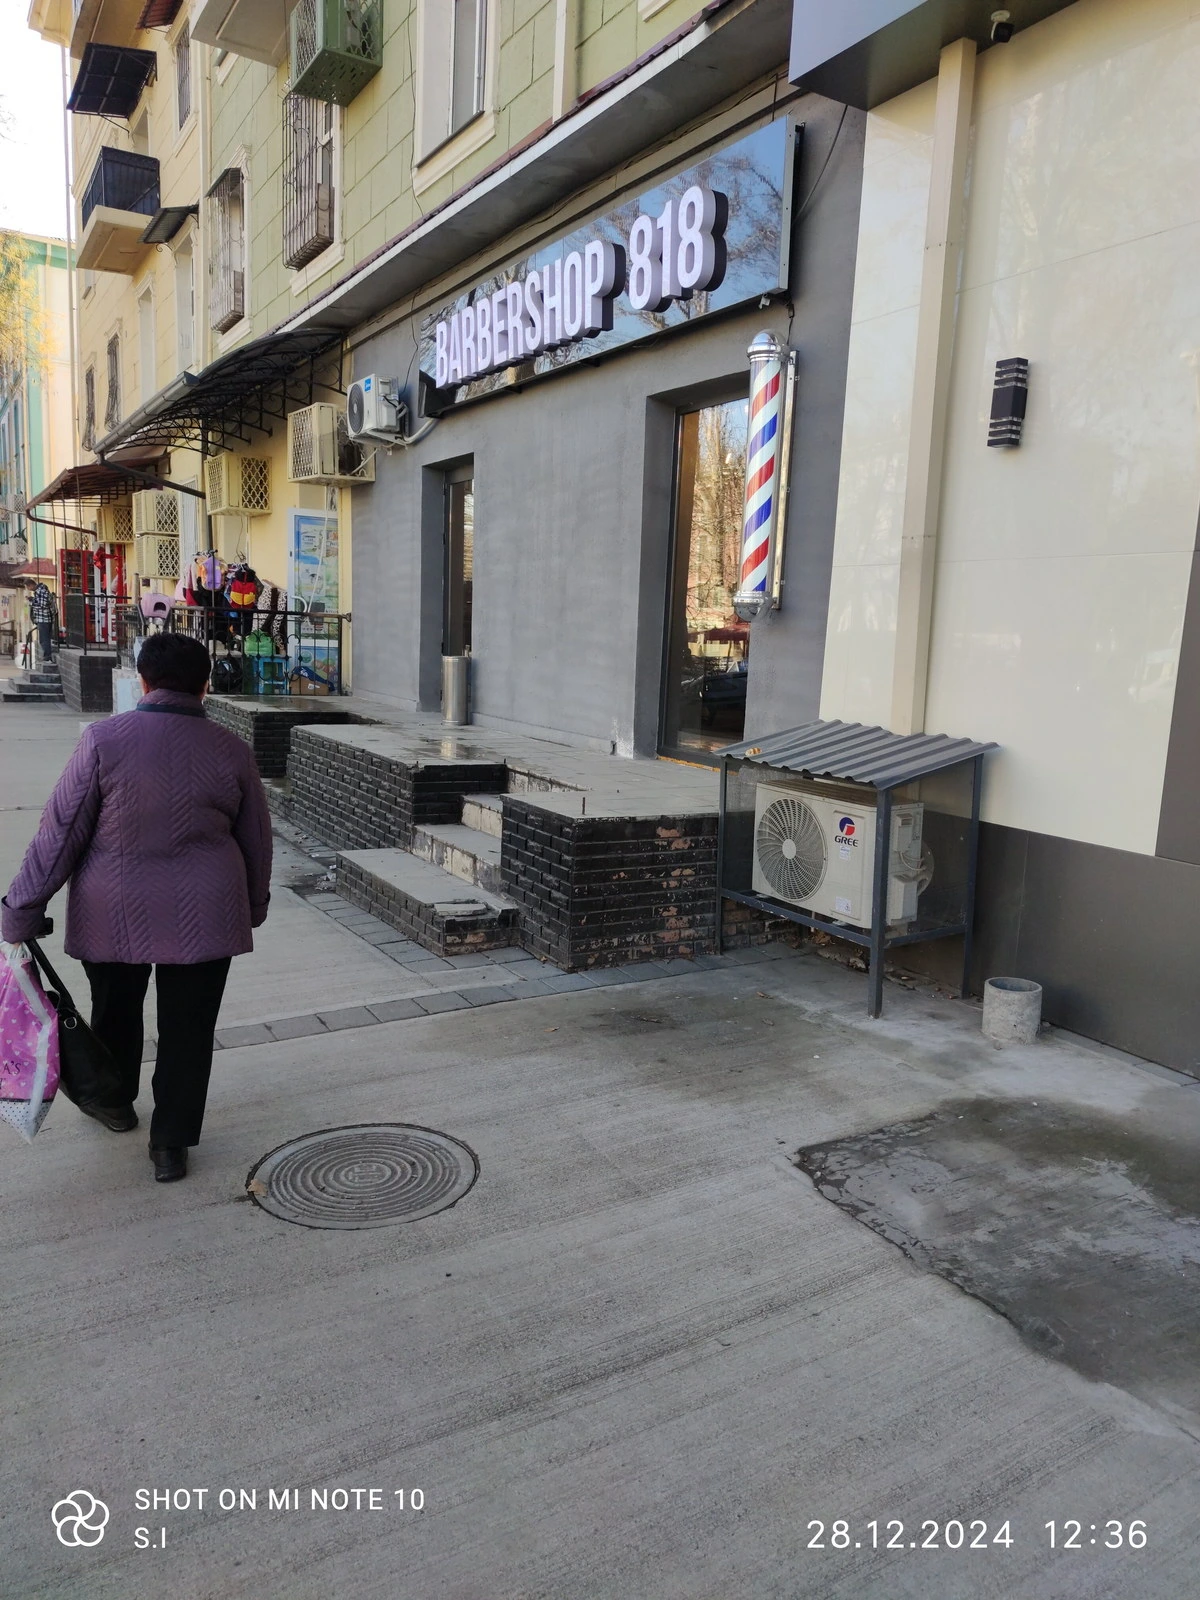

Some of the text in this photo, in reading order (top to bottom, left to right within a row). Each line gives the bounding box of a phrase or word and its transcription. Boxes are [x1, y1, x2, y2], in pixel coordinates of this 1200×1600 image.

[435, 185, 717, 389] BARBERSHOP 818
[835, 835, 858, 847] GREE
